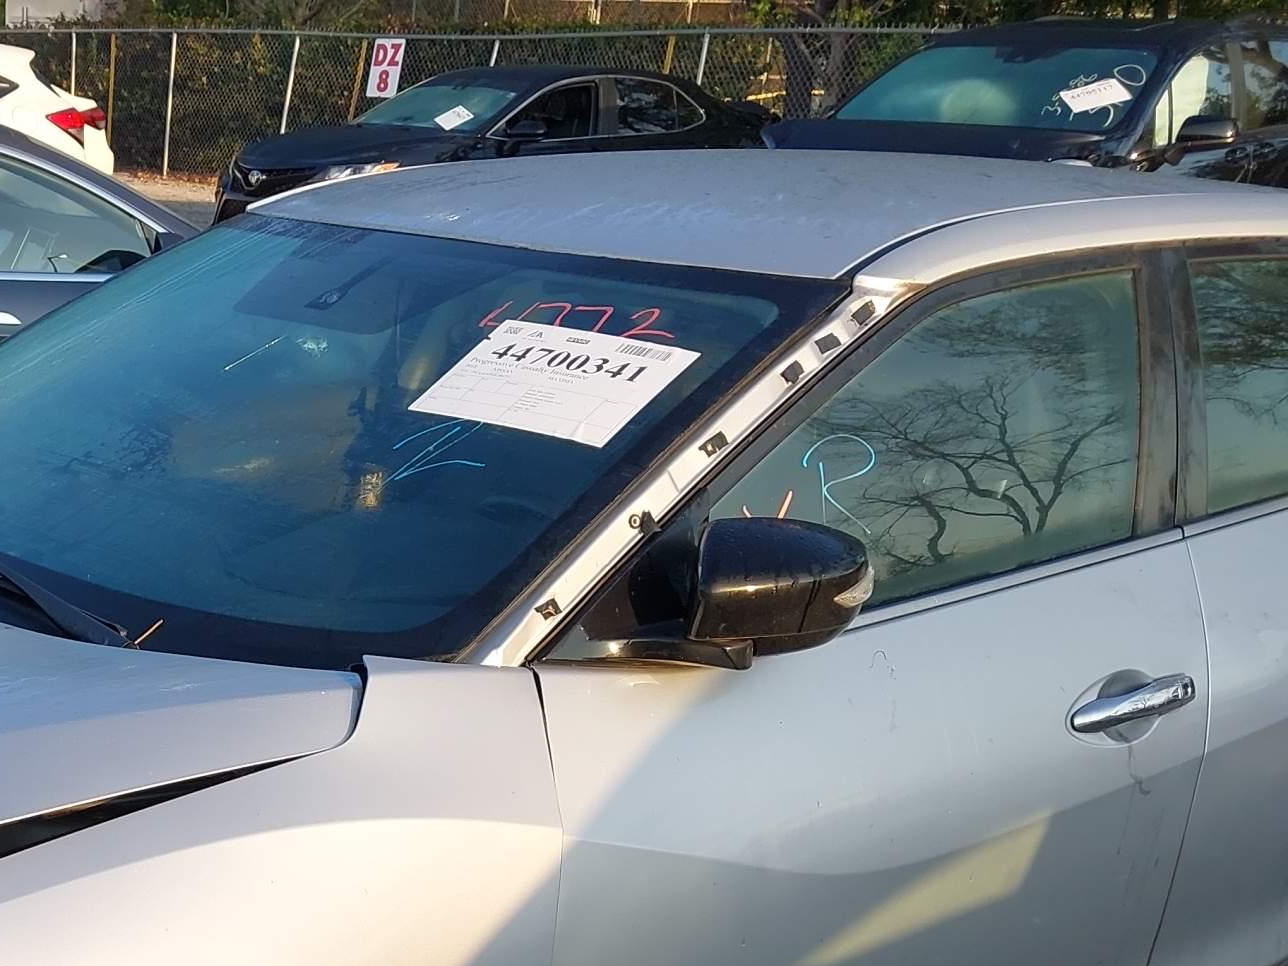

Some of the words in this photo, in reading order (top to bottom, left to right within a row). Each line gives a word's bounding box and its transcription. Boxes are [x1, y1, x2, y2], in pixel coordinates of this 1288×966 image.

[373, 43, 403, 67] DZ
[376, 69, 390, 93] 8
[491, 342, 649, 384] 44700341
[802, 433, 876, 535] R
